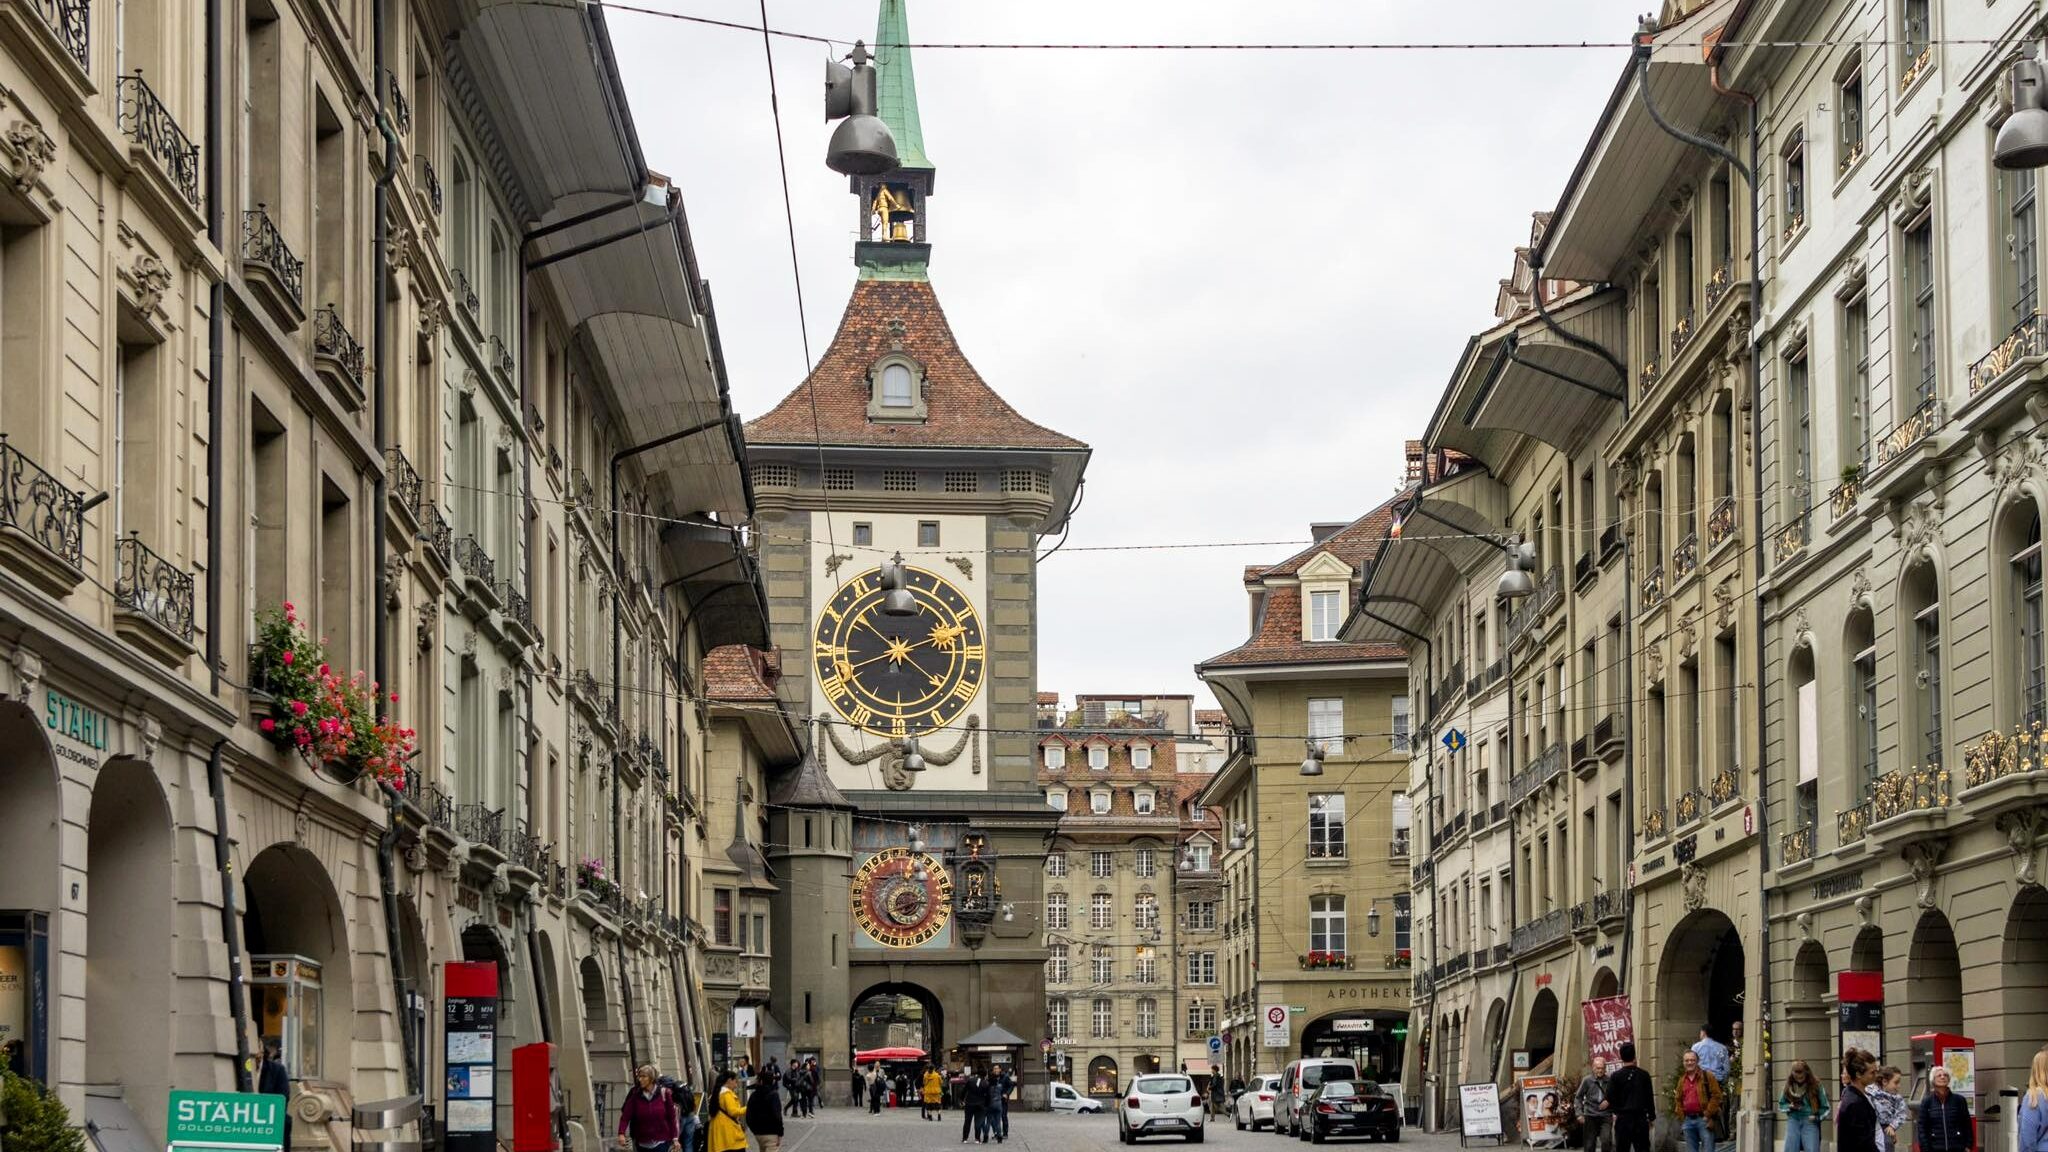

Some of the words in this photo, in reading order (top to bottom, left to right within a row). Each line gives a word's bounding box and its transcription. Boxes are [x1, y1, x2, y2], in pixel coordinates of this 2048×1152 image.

[1327, 986, 1412, 999] APOTHEKE
[447, 1004, 456, 1013] 12
[464, 1004, 475, 1013] 30
[178, 1099, 275, 1125] STÄHLI
[178, 1124, 274, 1136] GOLDSCHMIED
